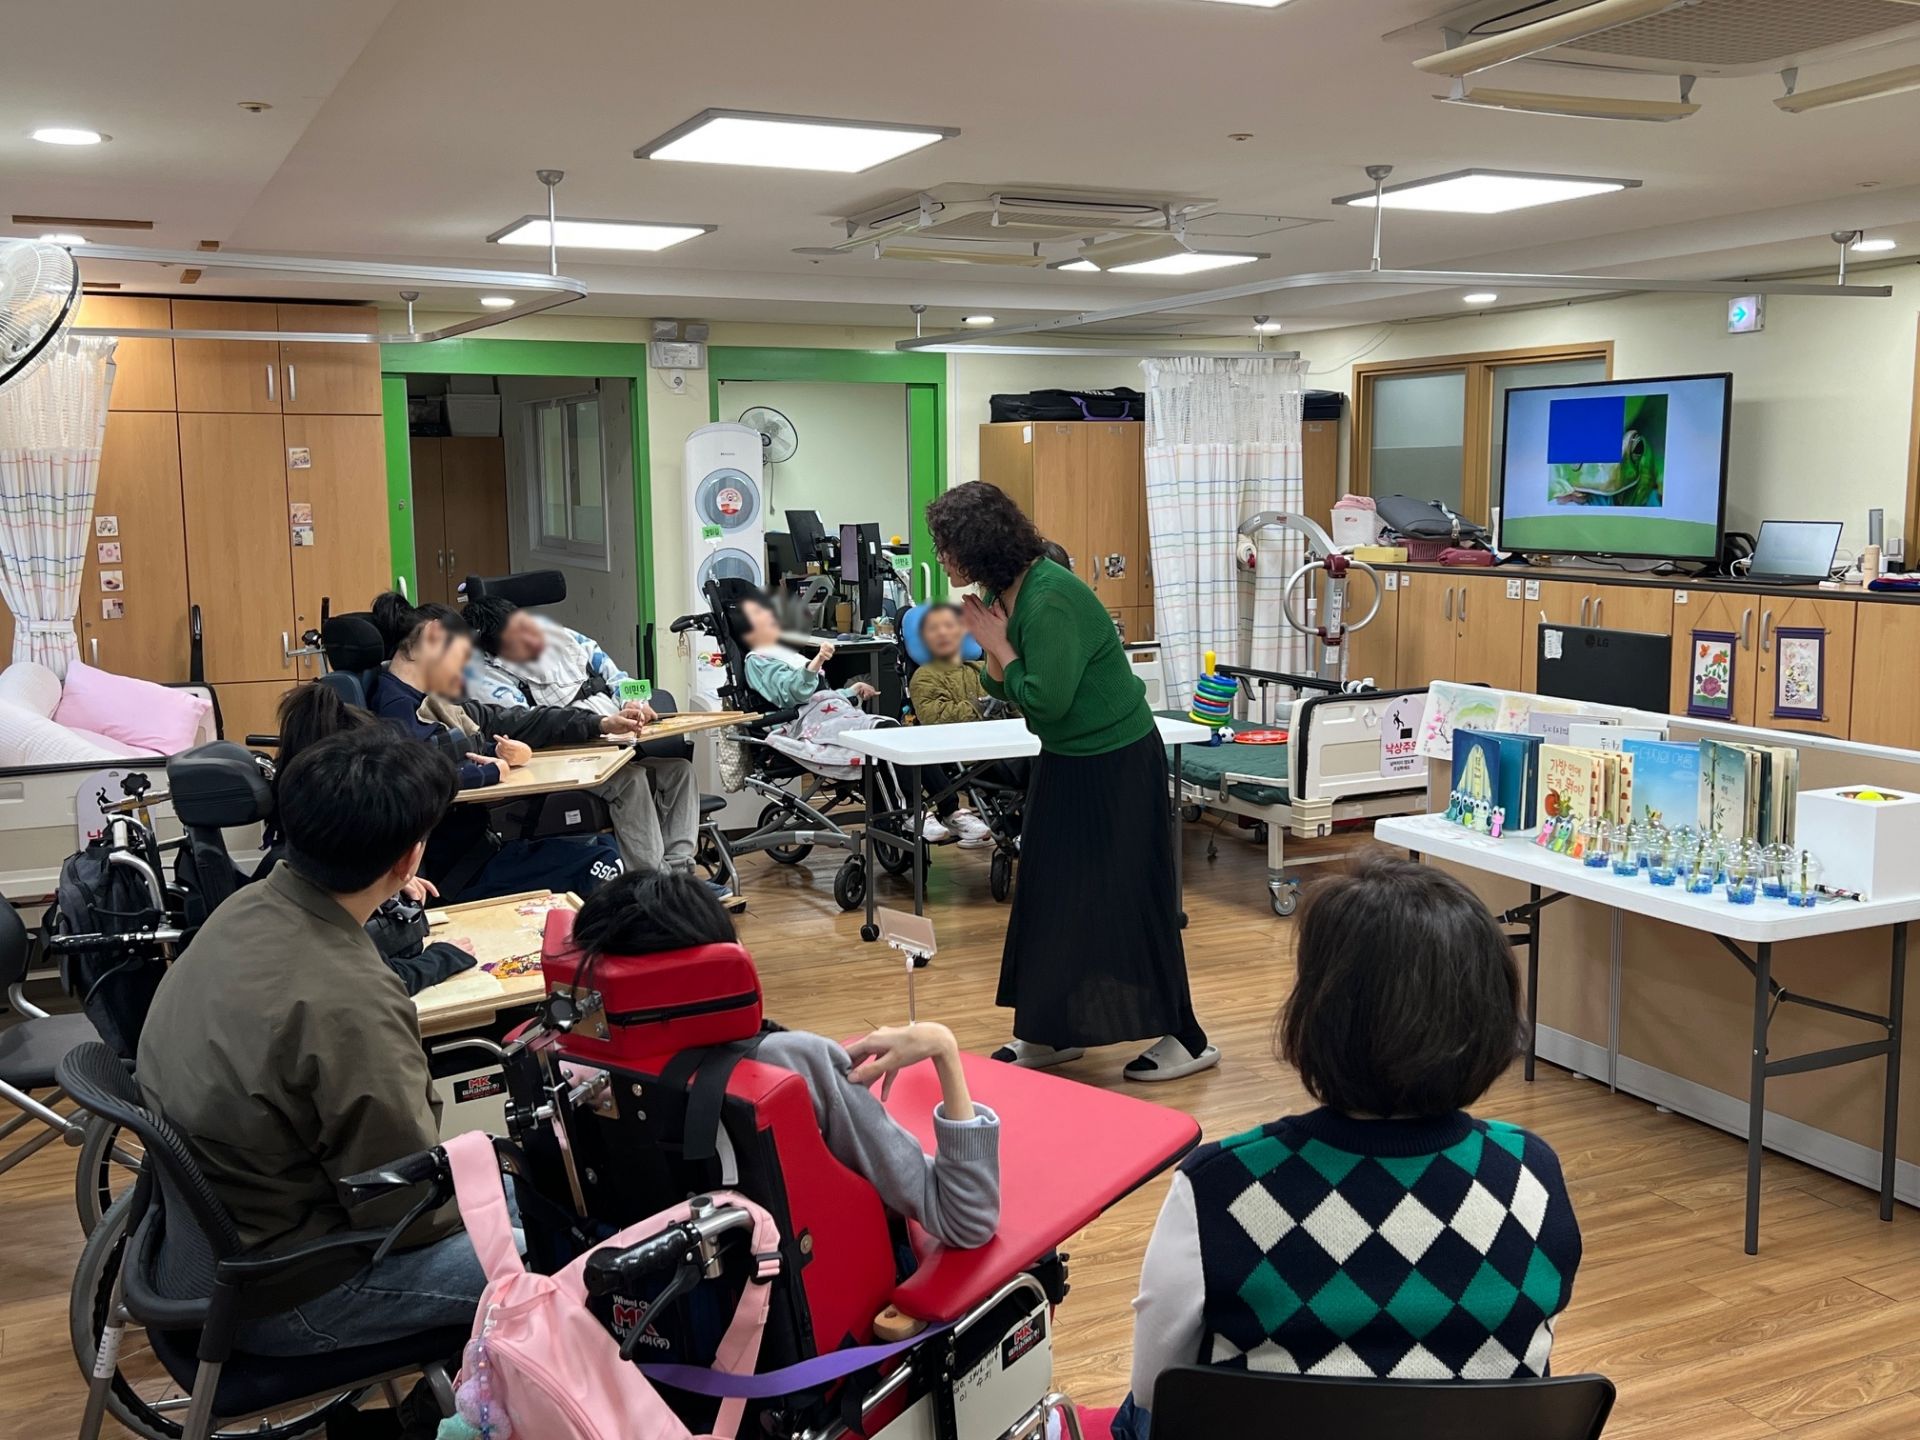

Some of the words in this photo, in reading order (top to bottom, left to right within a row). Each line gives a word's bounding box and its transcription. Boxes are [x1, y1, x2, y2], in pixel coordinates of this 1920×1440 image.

[1597, 636, 1609, 648] LG
[1550, 759, 1568, 776] 가방
[1568, 763, 1583, 777] 안에
[1565, 778, 1585, 797] 뭐야?
[468, 1076, 492, 1089] MK
[612, 1294, 638, 1308] Wheel
[1013, 1320, 1034, 1346] MK
